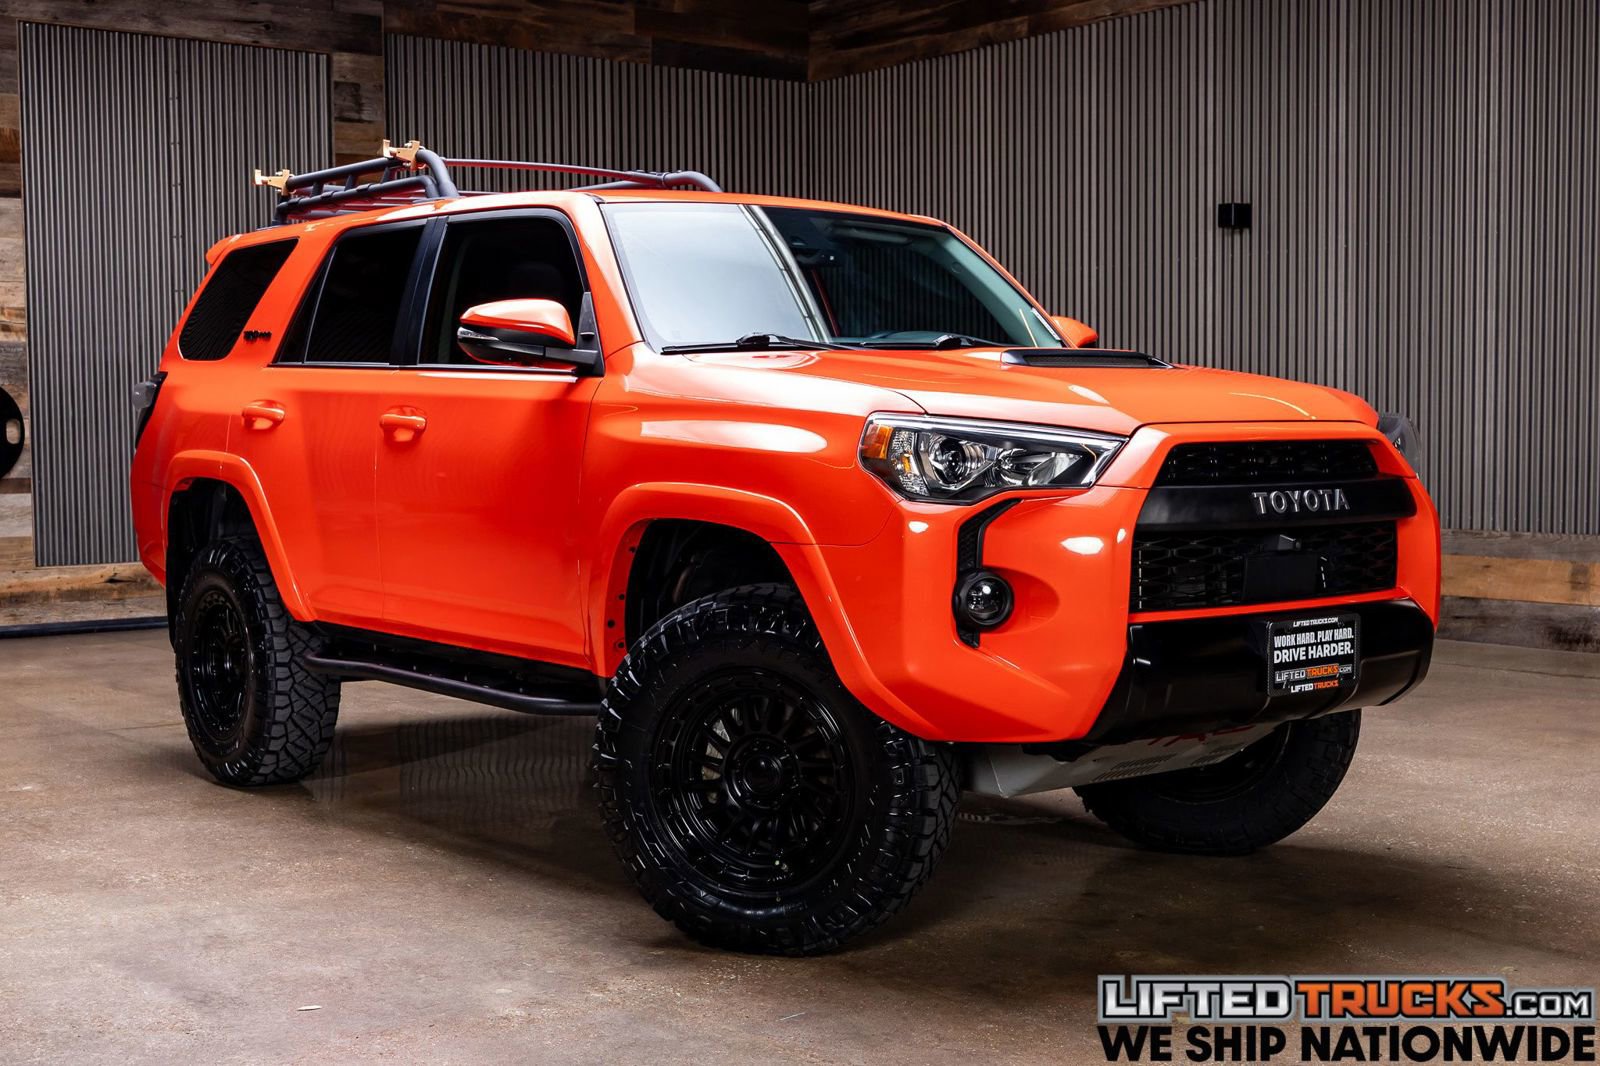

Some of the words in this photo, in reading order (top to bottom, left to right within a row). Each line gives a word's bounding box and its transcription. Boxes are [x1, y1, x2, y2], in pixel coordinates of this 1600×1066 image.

[1252, 488, 1350, 514] TOYOTA
[1273, 634, 1296, 648] WORK
[1296, 632, 1317, 645] HARD.
[1317, 629, 1333, 643] PLAY
[1334, 627, 1354, 640] HARD.
[1273, 647, 1306, 664] DRIVE
[1308, 641, 1354, 659] HARDER.
